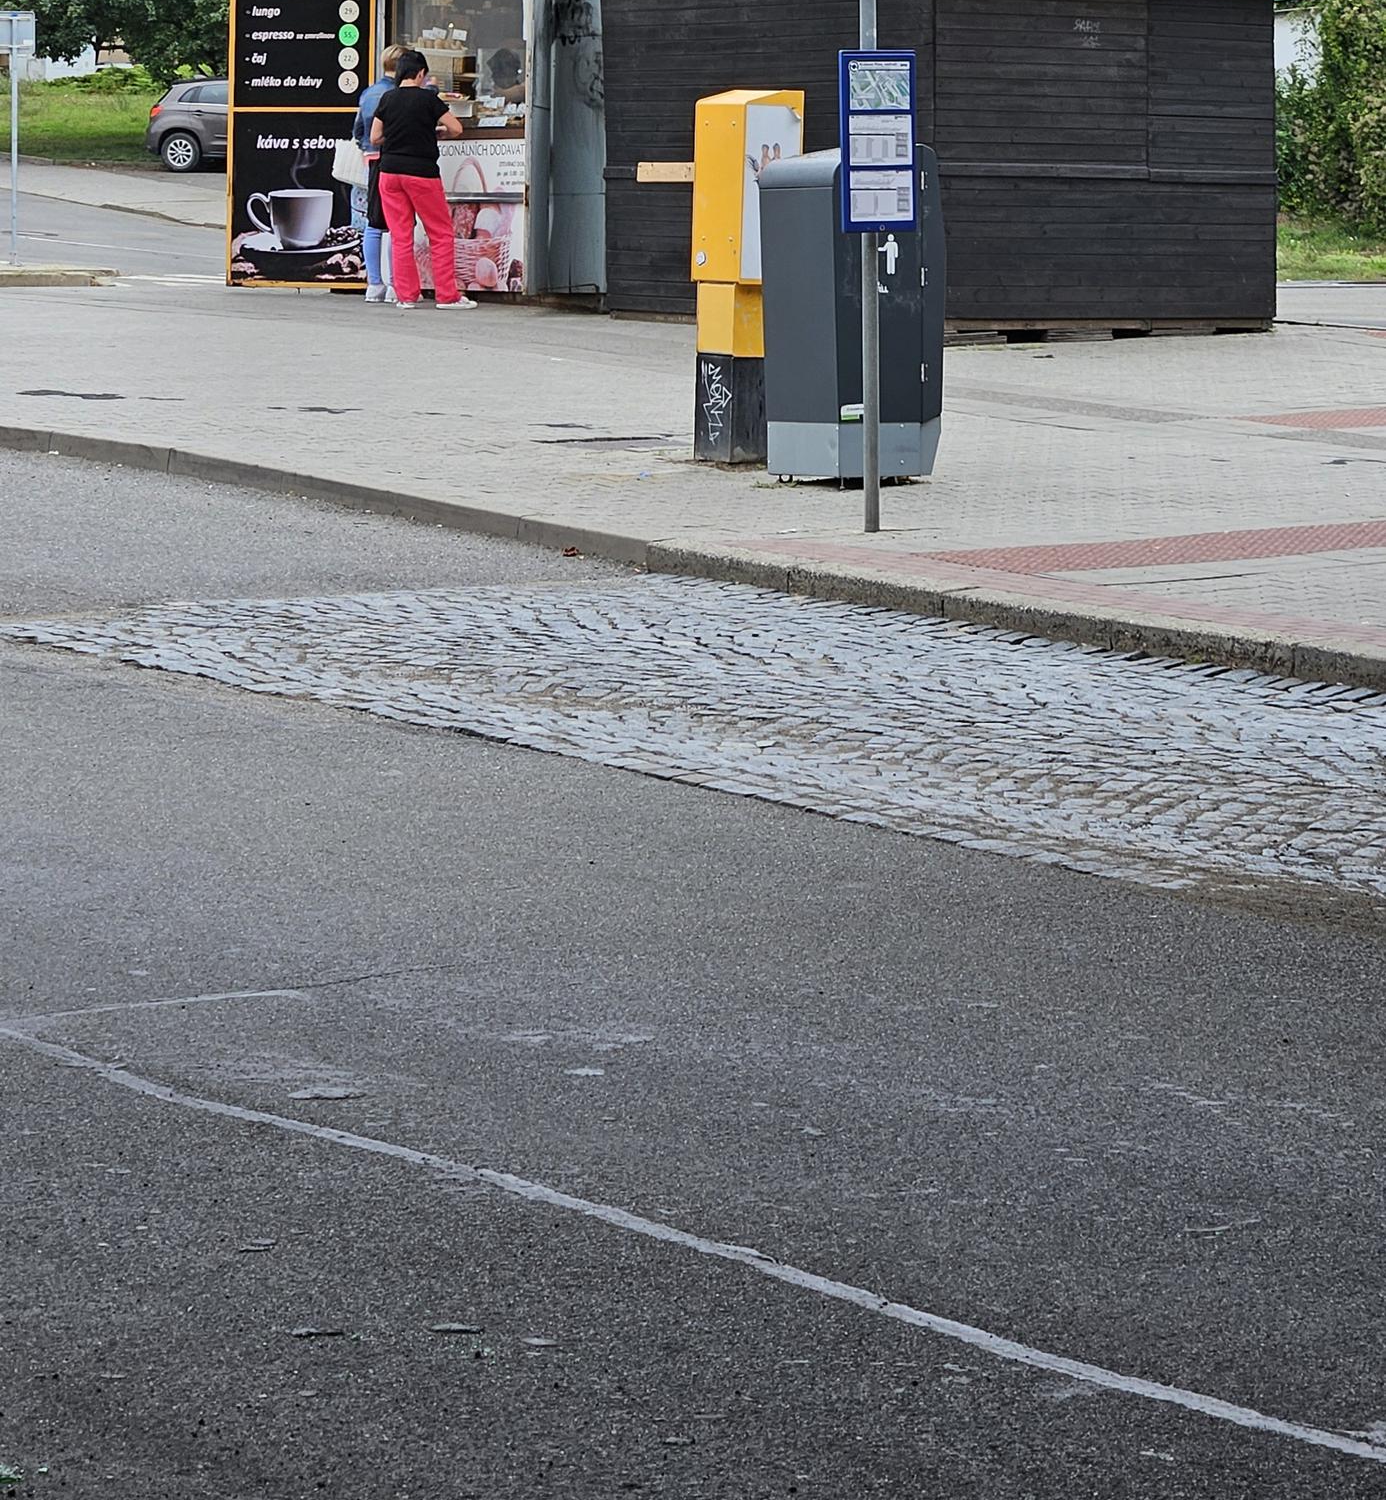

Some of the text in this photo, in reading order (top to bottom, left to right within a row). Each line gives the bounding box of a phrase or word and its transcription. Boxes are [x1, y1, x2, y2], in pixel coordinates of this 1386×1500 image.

[251, 5, 281, 19] lungo
[251, 31, 294, 42] espresso
[251, 52, 268, 66] čaj
[250, 75, 282, 87] mléko
[283, 75, 297, 87] do
[298, 75, 324, 89] kávy
[256, 134, 336, 149] káva s sebo
[438, 141, 526, 157] EGIONÁLNÍCH DODAVAT
